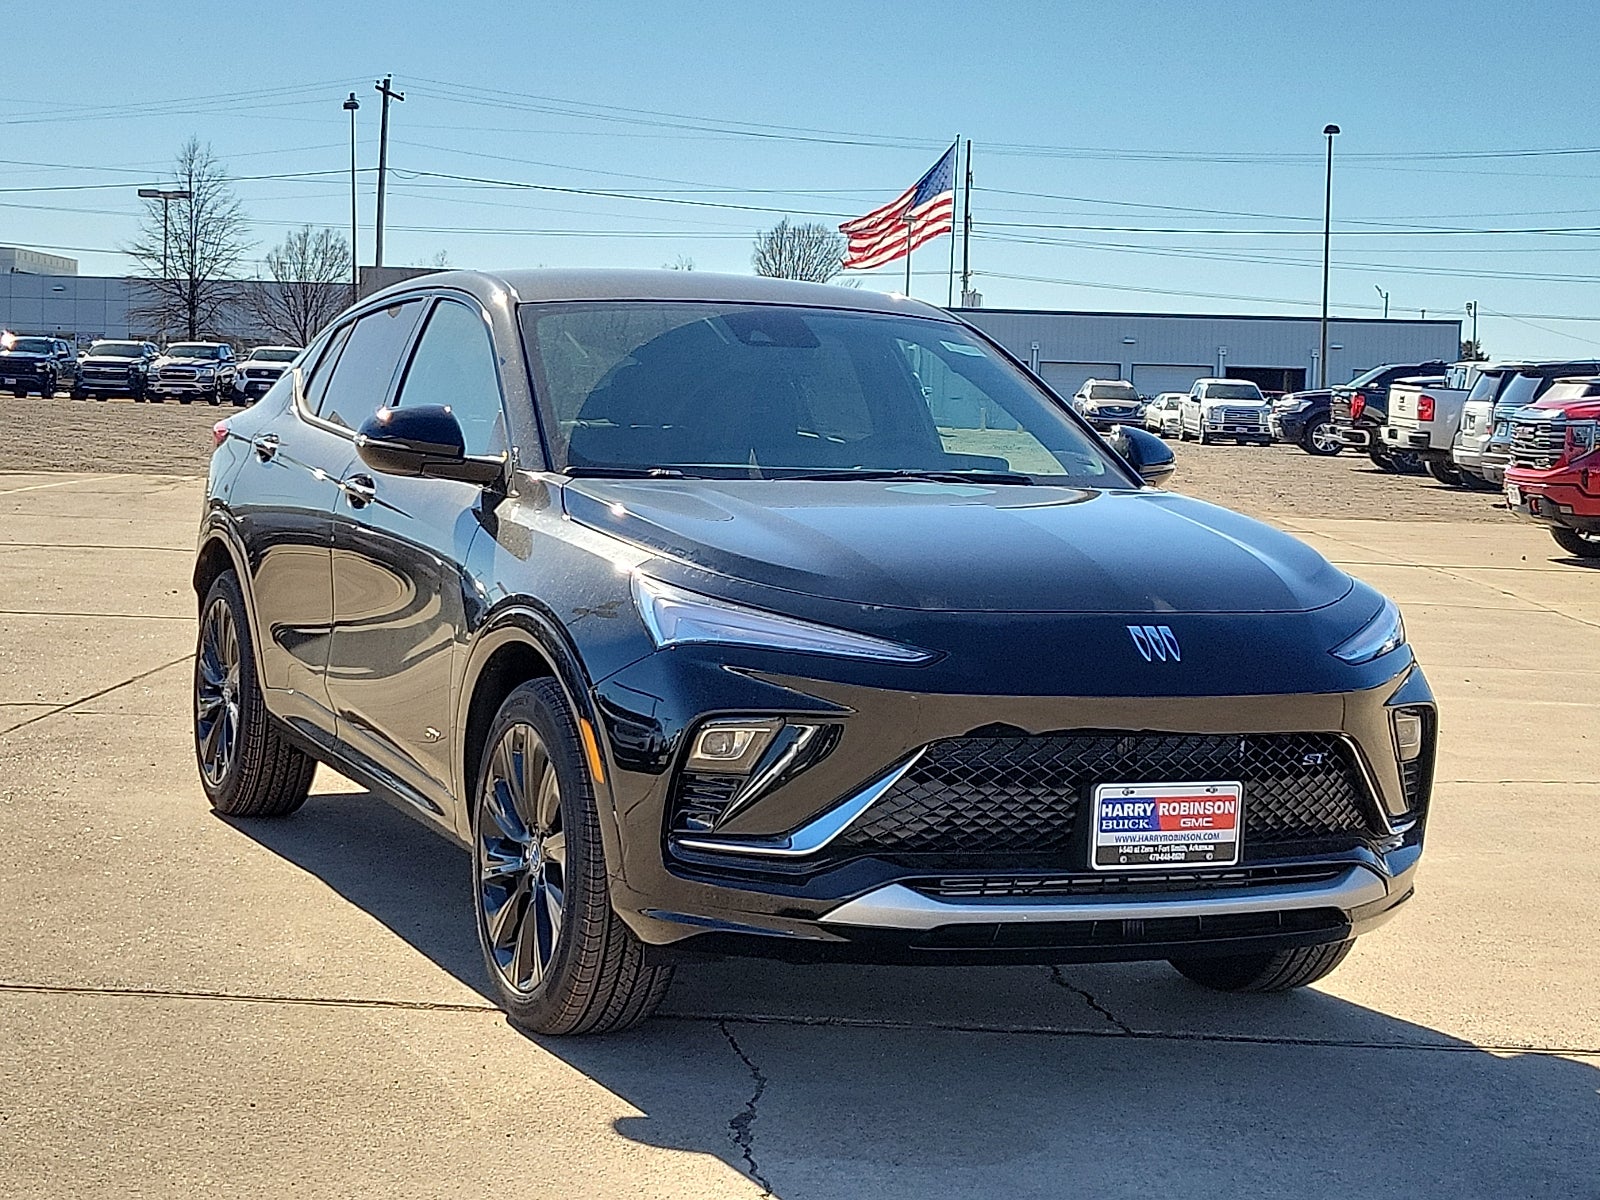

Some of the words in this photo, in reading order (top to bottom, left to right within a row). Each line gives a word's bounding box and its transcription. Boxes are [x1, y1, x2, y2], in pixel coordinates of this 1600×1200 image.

[1102, 803, 1155, 818] HARRY
[1159, 800, 1235, 816] ROBINSON
[1102, 819, 1151, 830] BUICK
[1180, 817, 1213, 827] GMC
[1115, 832, 1220, 843] WWW.HARRYROBINSON.COM
